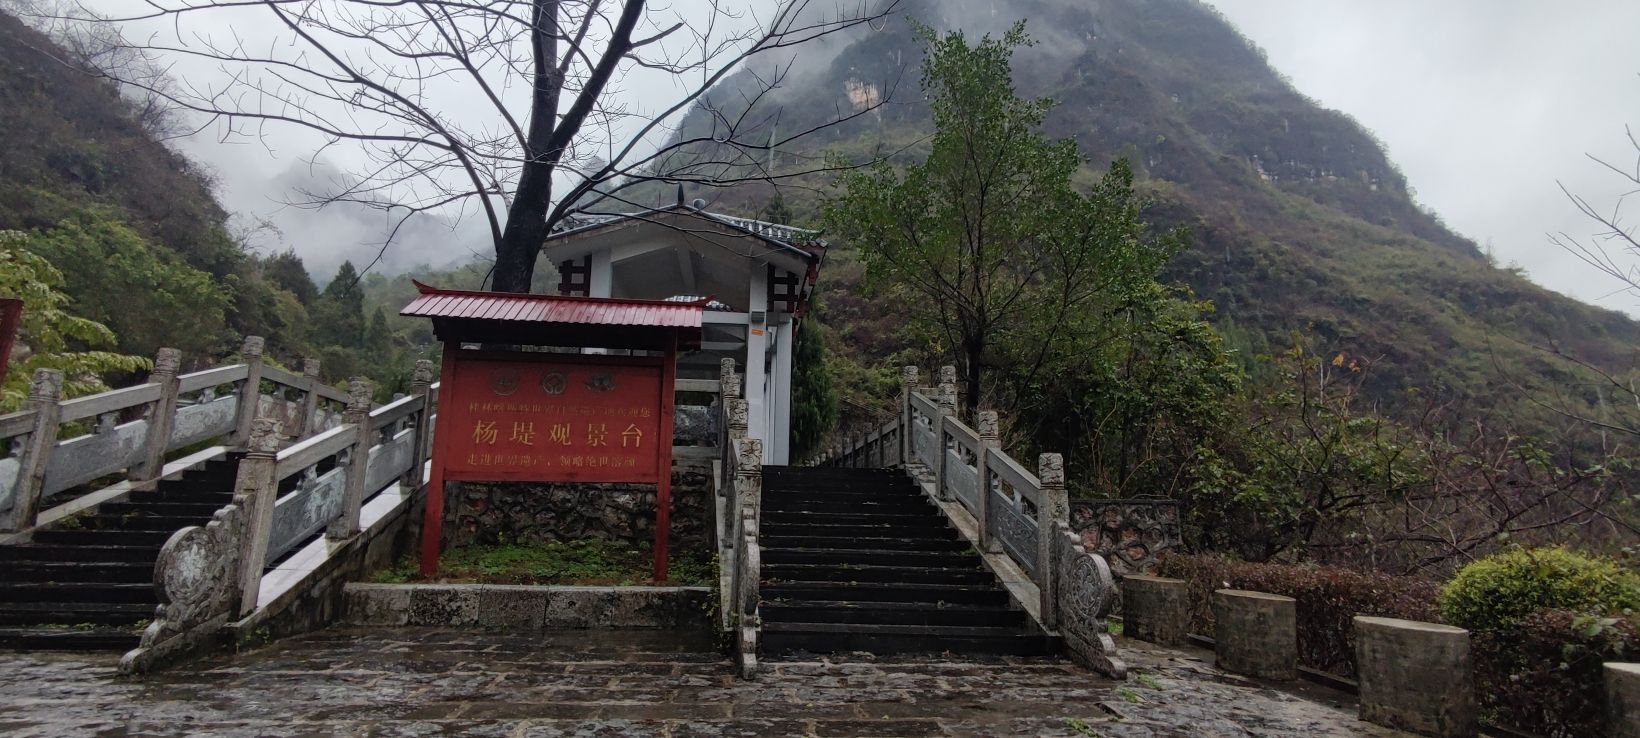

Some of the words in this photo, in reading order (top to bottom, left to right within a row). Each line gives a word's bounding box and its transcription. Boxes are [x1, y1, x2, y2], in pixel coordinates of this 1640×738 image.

[472, 420, 642, 447] 杨堤观景台
